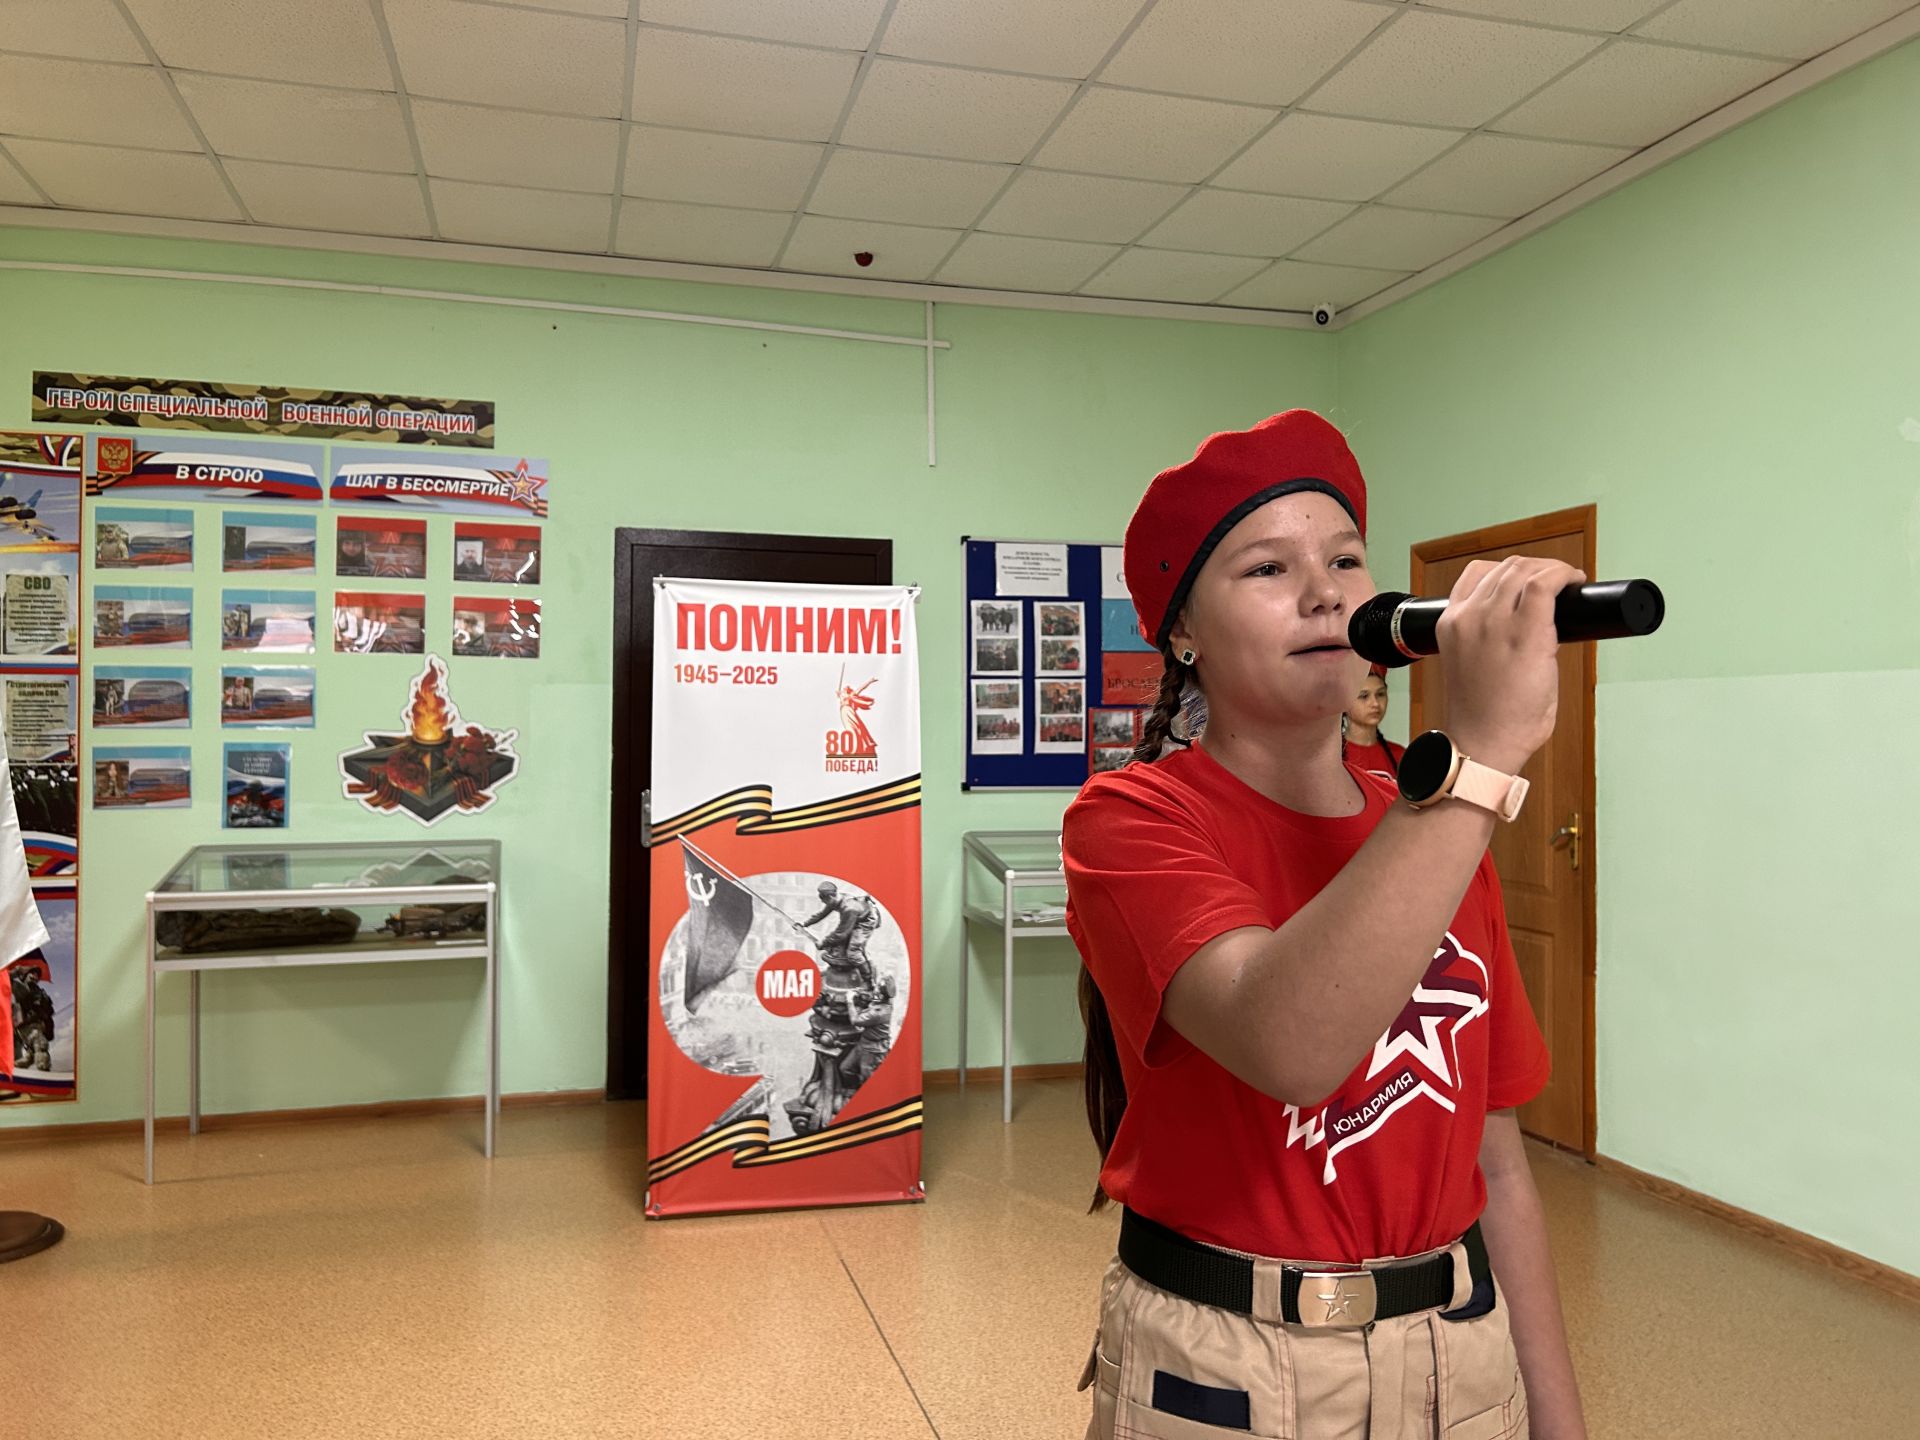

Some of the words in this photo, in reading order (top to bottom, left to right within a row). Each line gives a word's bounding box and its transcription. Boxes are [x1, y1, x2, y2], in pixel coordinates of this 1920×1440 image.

[47, 387, 113, 410] ГЕРОИ
[118, 392, 267, 419] СПЕЦИАЛЬНОЙ
[282, 404, 371, 427] ВОЕННОЙ
[377, 410, 474, 434] ОПЕРАЦИИ
[175, 465, 190, 480] В
[195, 466, 264, 484] СТРОЮ
[345, 473, 384, 489] ШАГ
[386, 476, 398, 490] В
[401, 476, 510, 497] БЕССМЕРТИЕ
[24, 576, 52, 590] СВО
[677, 602, 902, 655] ПОМНИМ!
[825, 730, 858, 756] 80
[825, 758, 879, 775] ПОБЕДА!
[763, 968, 815, 999] МАЯ
[1333, 1071, 1414, 1135] ЮНАРМИЯ
